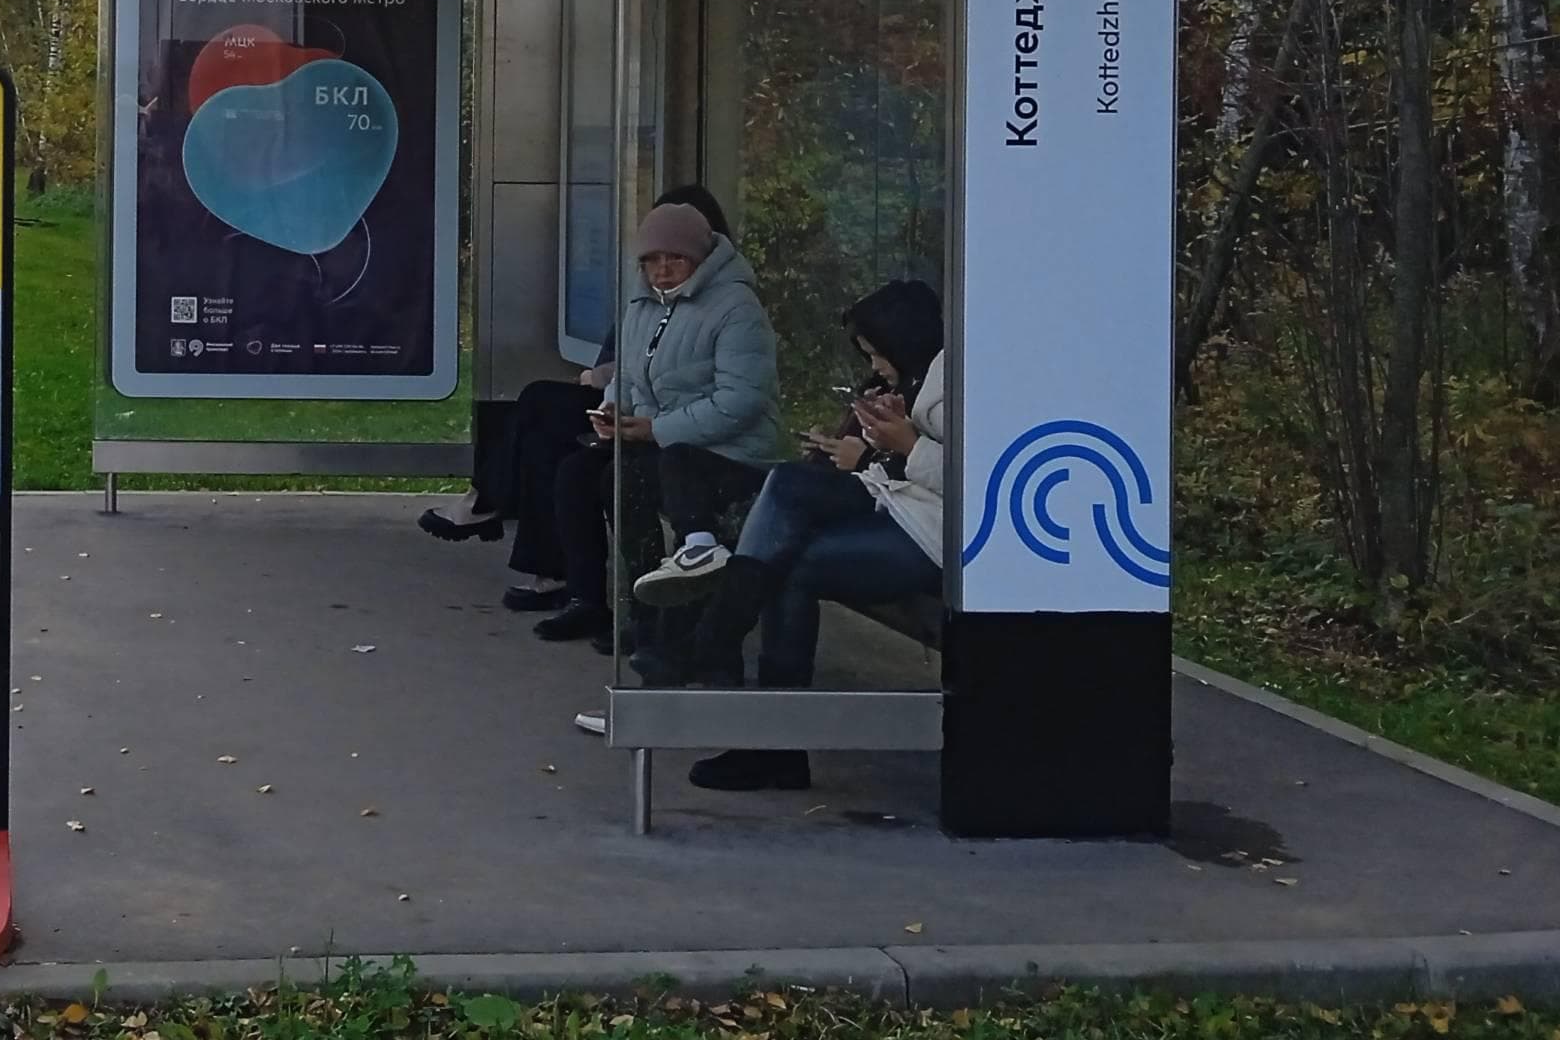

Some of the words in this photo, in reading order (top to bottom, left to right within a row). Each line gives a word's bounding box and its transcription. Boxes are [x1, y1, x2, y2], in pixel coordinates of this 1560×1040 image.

[224, 37, 256, 48] МЦК
[315, 87, 368, 106] БКЛ
[348, 114, 370, 130] 70
[210, 316, 228, 324] БКЛ
